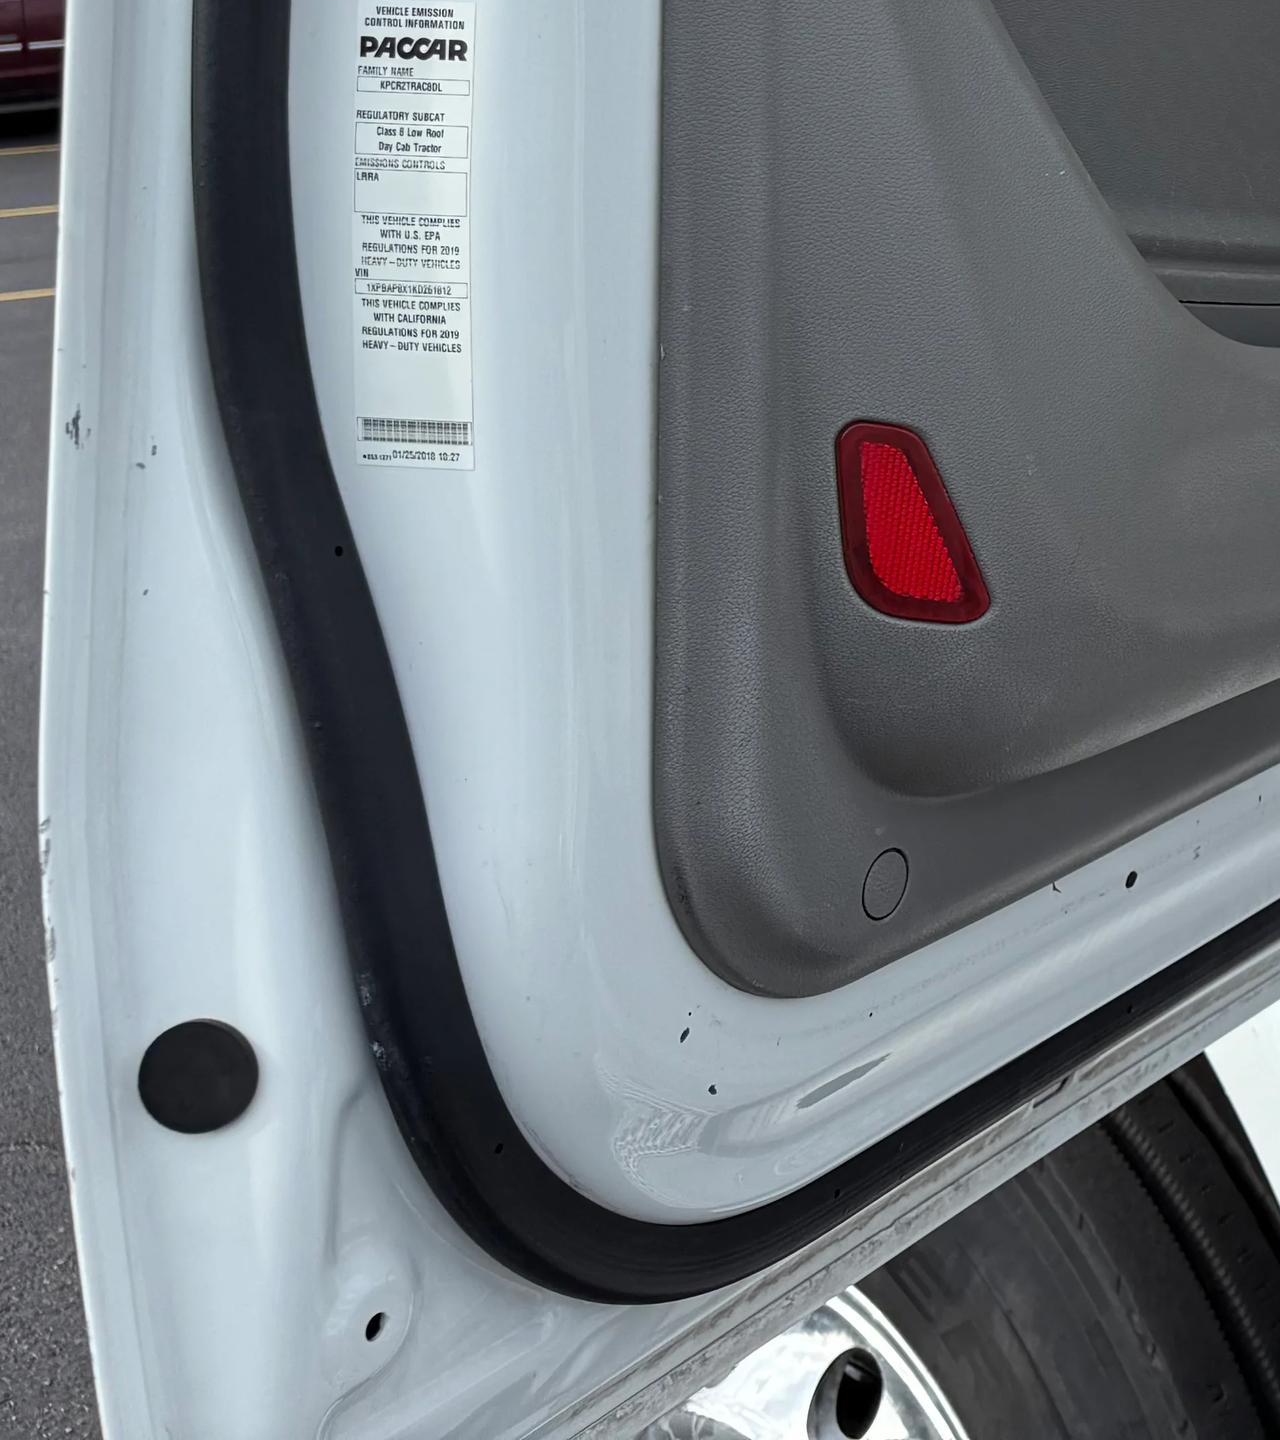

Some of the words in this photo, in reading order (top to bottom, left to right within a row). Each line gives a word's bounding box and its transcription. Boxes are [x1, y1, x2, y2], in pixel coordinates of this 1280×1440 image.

[376, 6, 409, 17] VEHICLE
[411, 7, 454, 18] EMISSION
[364, 17, 403, 28] CONTROL
[405, 19, 465, 30] INFORMATION
[360, 35, 468, 62] PACCAR
[357, 65, 388, 76] FAMILY
[391, 67, 414, 77] NAME
[356, 109, 410, 121] REGULATORY
[412, 112, 445, 122] SUBCAT
[376, 126, 397, 136] Class
[407, 128, 423, 137] Low
[426, 128, 445, 139] Roof
[378, 141, 393, 153] Day
[396, 142, 411, 152] Cab
[413, 143, 442, 153] Tractor
[354, 157, 399, 169] EMISSIONS
[401, 159, 446, 170] CONTROLS
[361, 214, 380, 225] THIS
[382, 216, 416, 227] VEHICLE
[418, 217, 461, 228] COMPLIES
[379, 229, 402, 239] WITH
[404, 230, 421, 240] U.S.
[424, 231, 441, 241] EPA
[362, 242, 418, 254] REGULATIONS
[421, 244, 438, 255] FOR
[440, 245, 460, 256] 2019
[421, 258, 461, 270] VEHICLES
[354, 268, 369, 278] VIN
[361, 298, 380, 308] THIS
[382, 299, 416, 310] VEHICLE
[418, 300, 461, 312] COMPLIES
[373, 312, 395, 323] WITH
[397, 313, 446, 325] CALIFORNIA
[361, 326, 418, 338] REGULATIONS
[421, 328, 438, 339] FOR
[440, 329, 460, 340] 2019
[422, 342, 462, 353] VEHICLES
[392, 449, 436, 461] 01/25/2018
